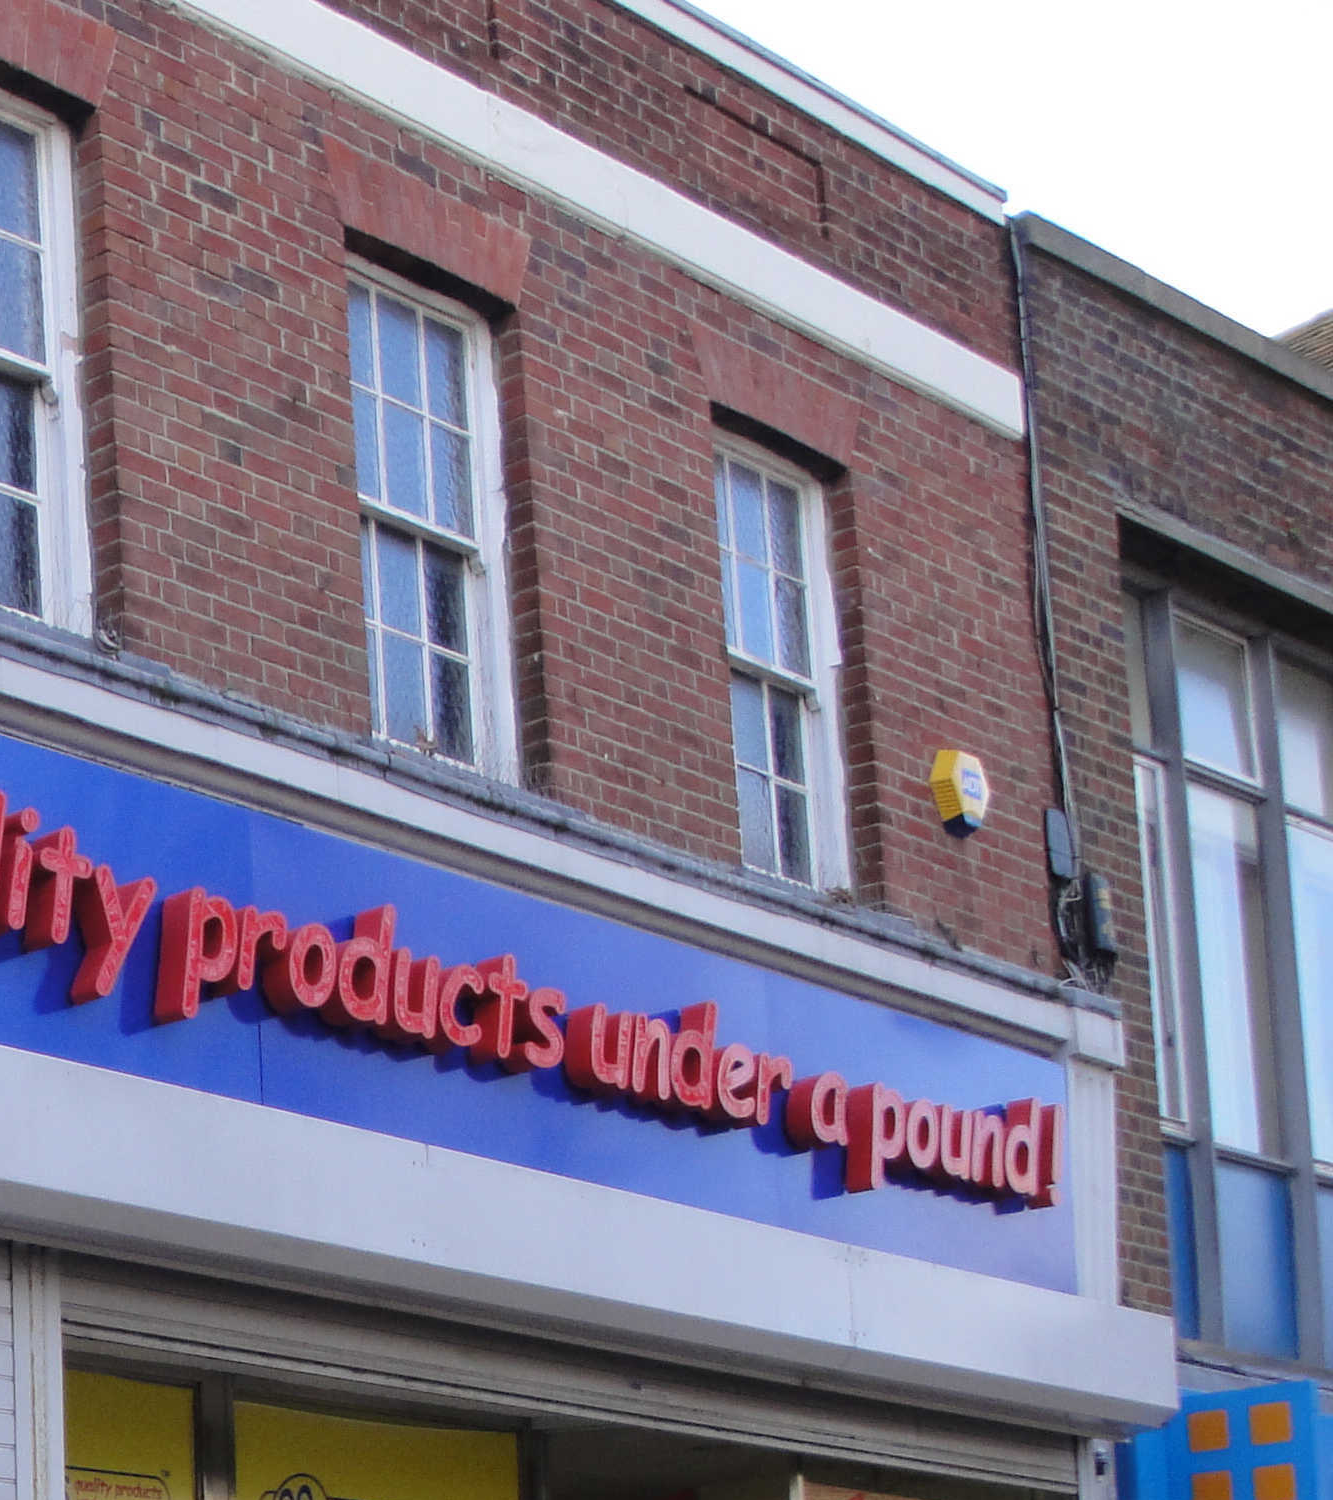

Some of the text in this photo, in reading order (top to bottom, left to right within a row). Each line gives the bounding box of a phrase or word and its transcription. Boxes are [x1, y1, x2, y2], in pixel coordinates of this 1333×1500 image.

[155, 885, 567, 1070] products
[567, 1000, 793, 1127] under
[788, 1072, 848, 1149] a
[846, 1097, 1063, 1209] pound!
[74, 1477, 112, 1500] quality
